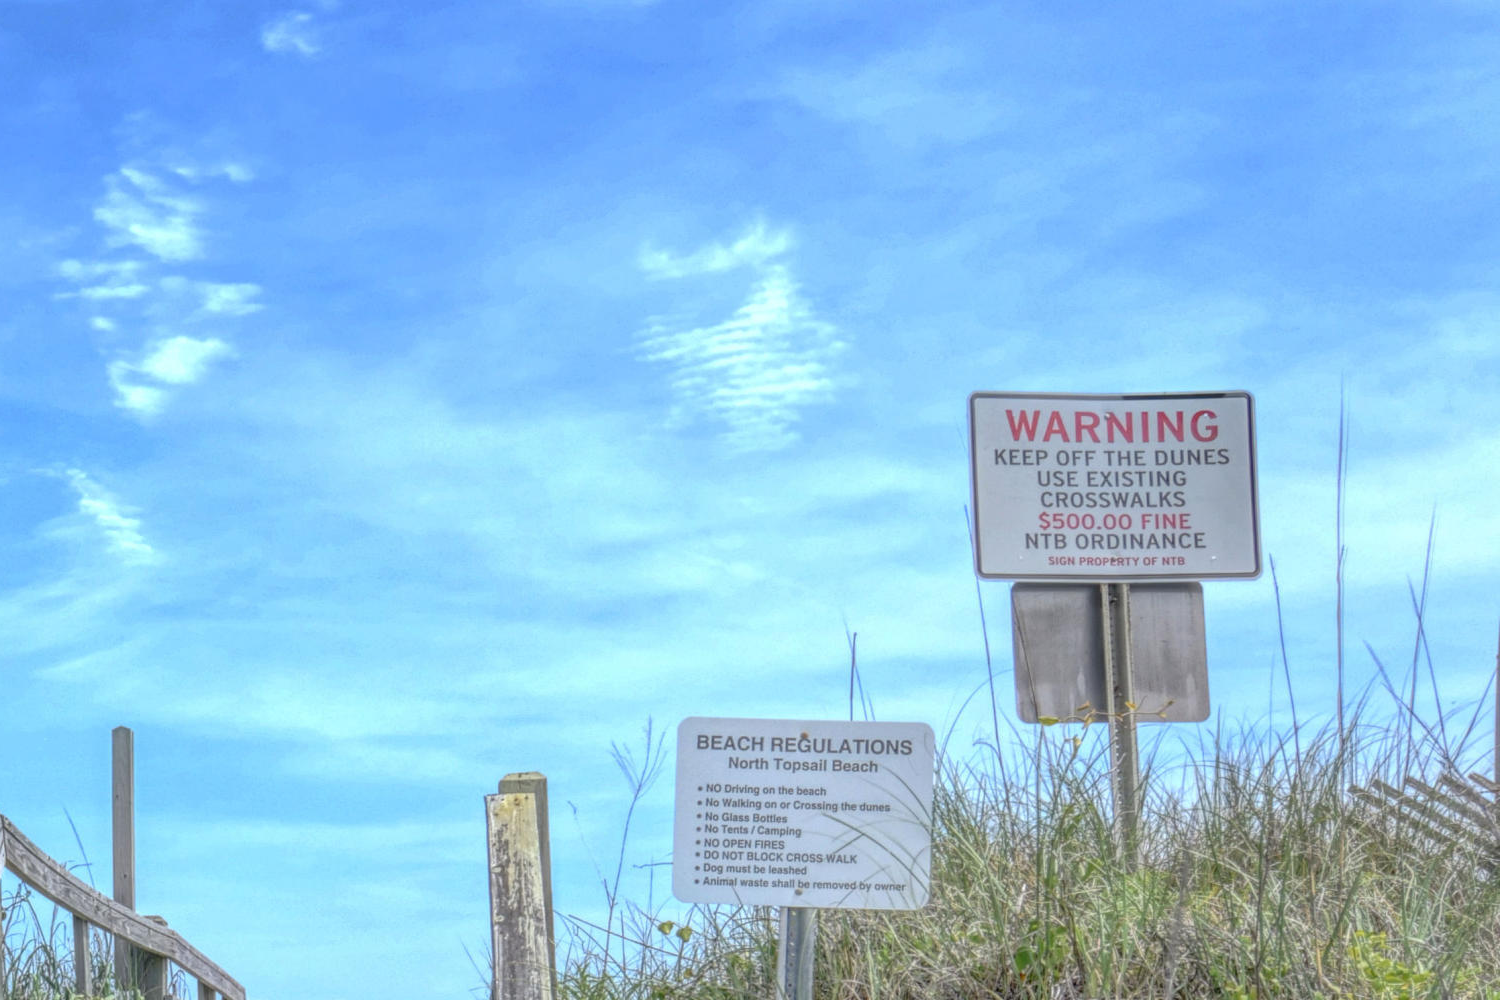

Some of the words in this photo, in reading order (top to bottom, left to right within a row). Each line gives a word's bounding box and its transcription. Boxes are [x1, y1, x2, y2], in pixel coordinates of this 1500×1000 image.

[1005, 410, 1219, 443] WARNING
[994, 449, 1048, 466] KEEP
[1056, 449, 1096, 466] OFF
[1104, 449, 1145, 466] THE
[1155, 449, 1230, 466] DUNES
[1037, 471, 1078, 487] USE
[1087, 471, 1186, 487] EXISTING
[1041, 492, 1186, 508] CROSSWALKS
[1038, 512, 1132, 531] $500.00
[1141, 514, 1191, 530] FINE
[1025, 533, 1067, 549] NTB
[1076, 533, 1206, 549] ORDINANCE
[1048, 556, 1075, 566] SIGN
[1079, 556, 1139, 566] PROPERTY
[1143, 556, 1157, 566] OF
[1162, 556, 1185, 566] NTB
[697, 735, 764, 751] BEACH
[771, 737, 912, 755] REGULATIONS
[729, 757, 768, 770] North
[774, 758, 827, 773] Topsail
[832, 760, 878, 772] Beach
[706, 784, 721, 793] NO
[725, 785, 760, 796] Driving
[778, 786, 794, 795] the
[796, 787, 826, 796] beach
[706, 798, 719, 807] No
[722, 799, 761, 810] Walking
[793, 801, 837, 812] Crossing
[841, 803, 856, 811] the
[859, 803, 890, 812] dunes
[705, 813, 719, 821] No
[722, 813, 750, 822] Glass
[752, 814, 787, 823] Bottles
[704, 825, 718, 834] No
[722, 825, 748, 834] Tents
[751, 826, 755, 835] /
[757, 826, 801, 838] Camping
[704, 839, 719, 848] NO
[722, 839, 751, 849] OPEN
[755, 840, 785, 850] FIRES
[704, 851, 718, 860] DO
[722, 852, 744, 861] NOT
[747, 852, 783, 862] BLOCK
[786, 854, 823, 863] CROSS
[826, 854, 857, 864] WALK
[703, 864, 723, 875] Dog
[726, 865, 751, 874] must
[754, 866, 766, 874] be
[769, 866, 807, 875] leashed
[703, 877, 737, 887] Animal
[740, 879, 769, 887] waste
[772, 879, 795, 888] shall
[798, 880, 810, 889] be
[812, 881, 856, 890] removed
[859, 882, 871, 892] by
[874, 884, 906, 892] owner
